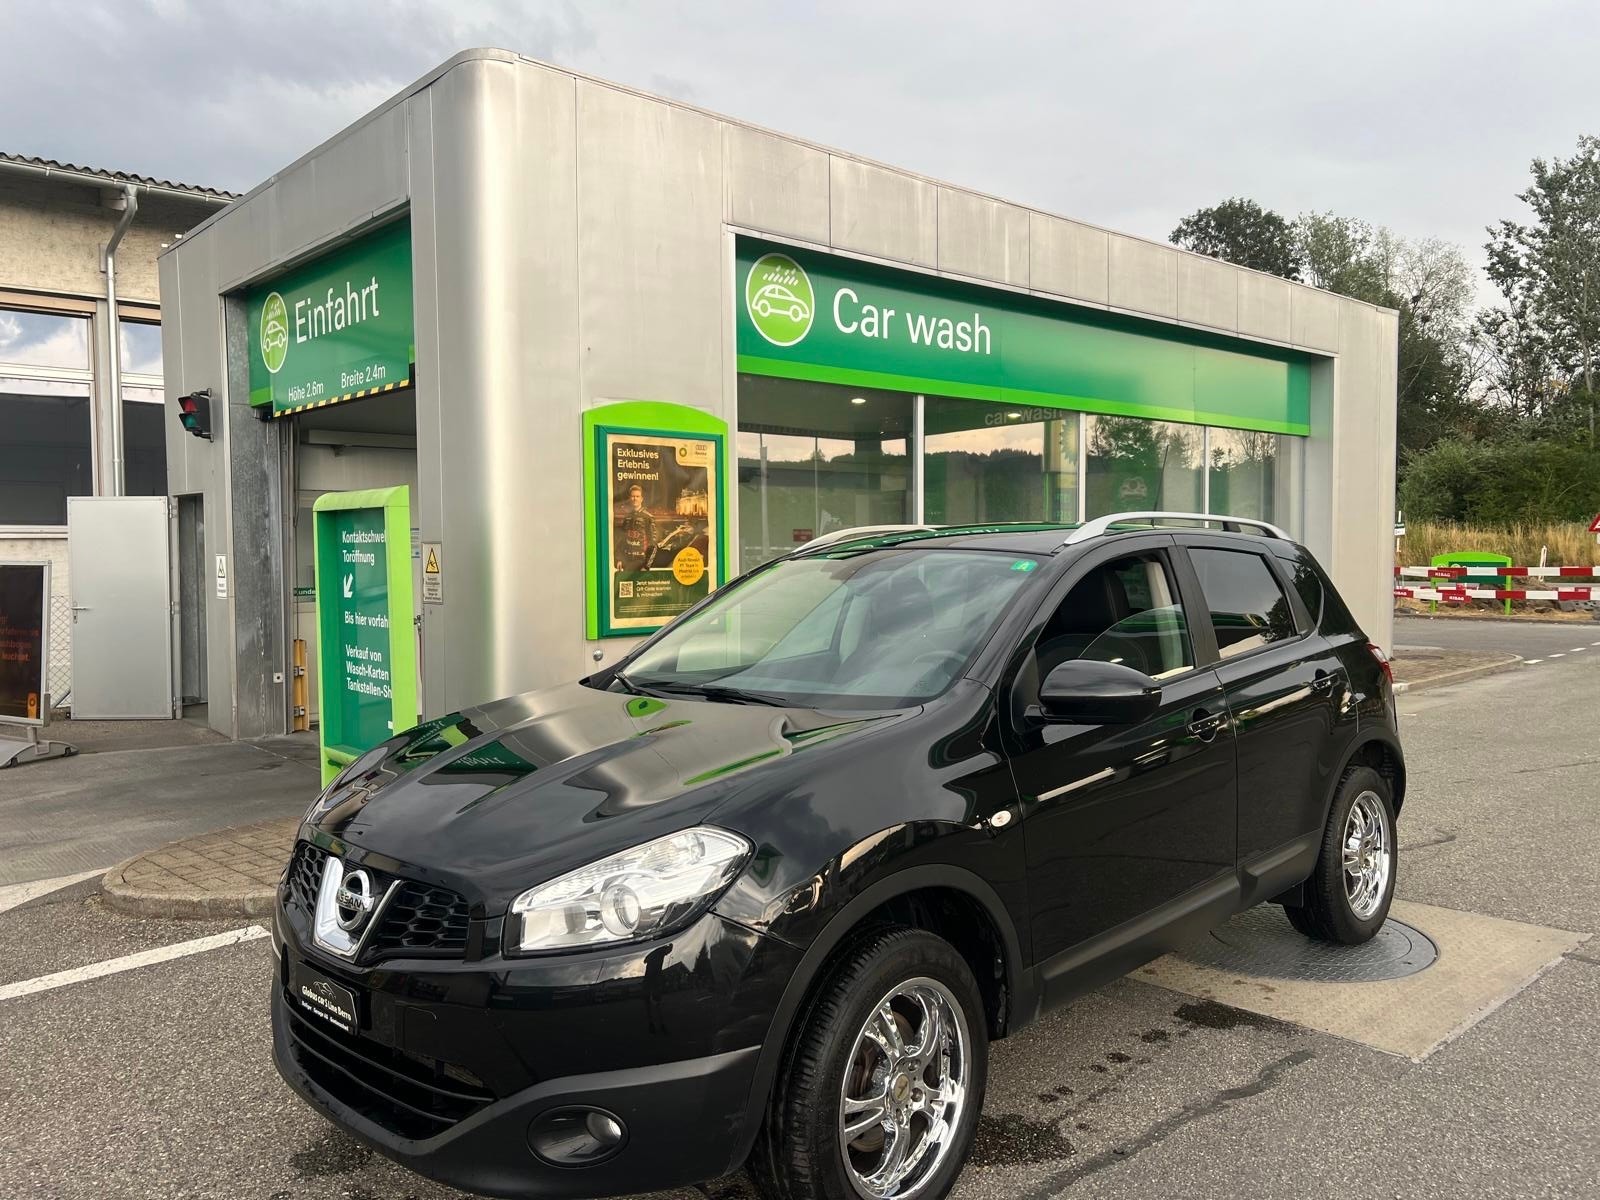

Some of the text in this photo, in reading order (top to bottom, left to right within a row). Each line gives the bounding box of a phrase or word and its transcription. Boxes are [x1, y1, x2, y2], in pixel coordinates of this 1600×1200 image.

[295, 276, 380, 344] Einfahrt
[833, 288, 992, 355] Car wash
[341, 364, 386, 389] Breite 2.4m
[288, 381, 324, 402] Höhe 2.6m
[617, 447, 659, 459] Exklusives
[617, 459, 650, 470] Erlebnis
[617, 471, 659, 481] gewinnen!
[342, 549, 375, 567] Toröffnung
[344, 611, 354, 624] Bis
[355, 612, 367, 626] hier
[345, 644, 382, 662] Verkauf von
[346, 661, 389, 680] Wasch-Karten
